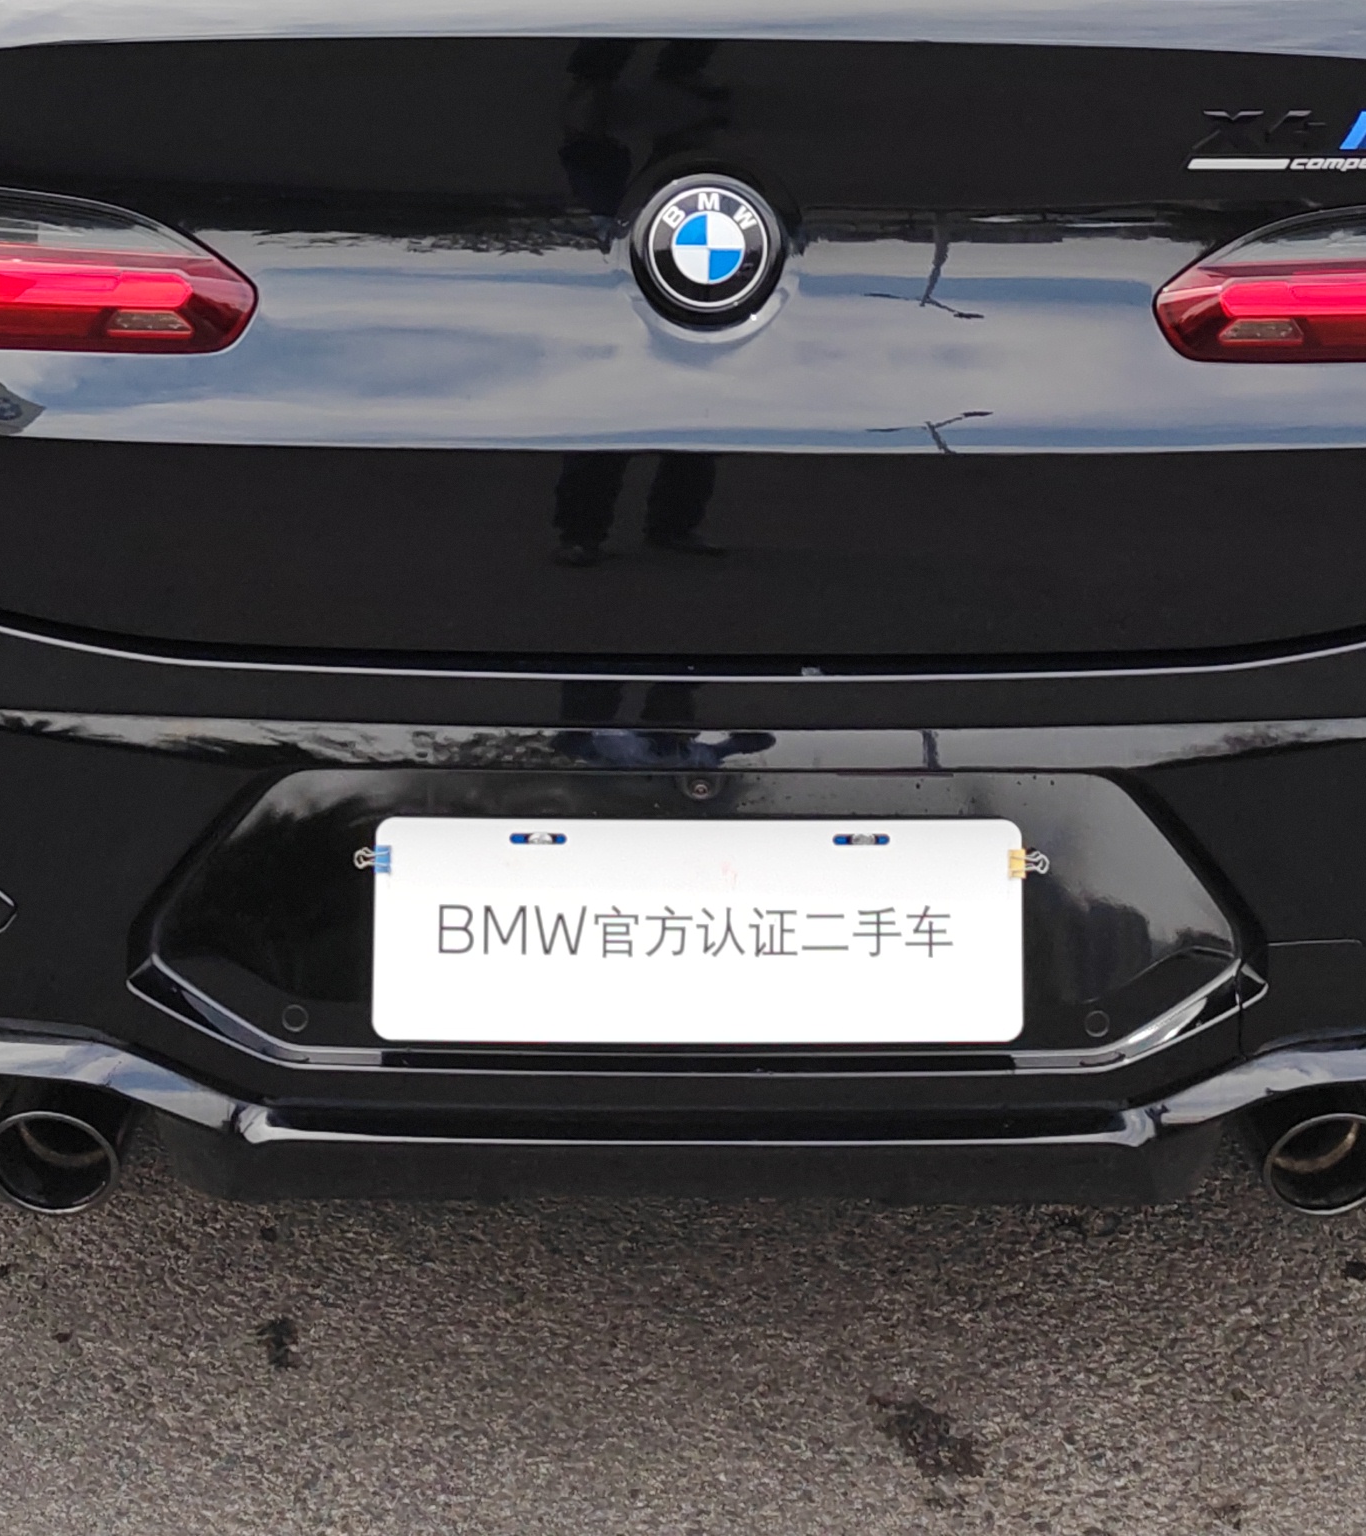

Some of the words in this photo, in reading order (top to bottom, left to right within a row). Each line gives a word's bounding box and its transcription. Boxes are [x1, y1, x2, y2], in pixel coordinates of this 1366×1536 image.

[662, 192, 757, 230] BMW
[437, 903, 954, 958] BMW官方认证二手车
